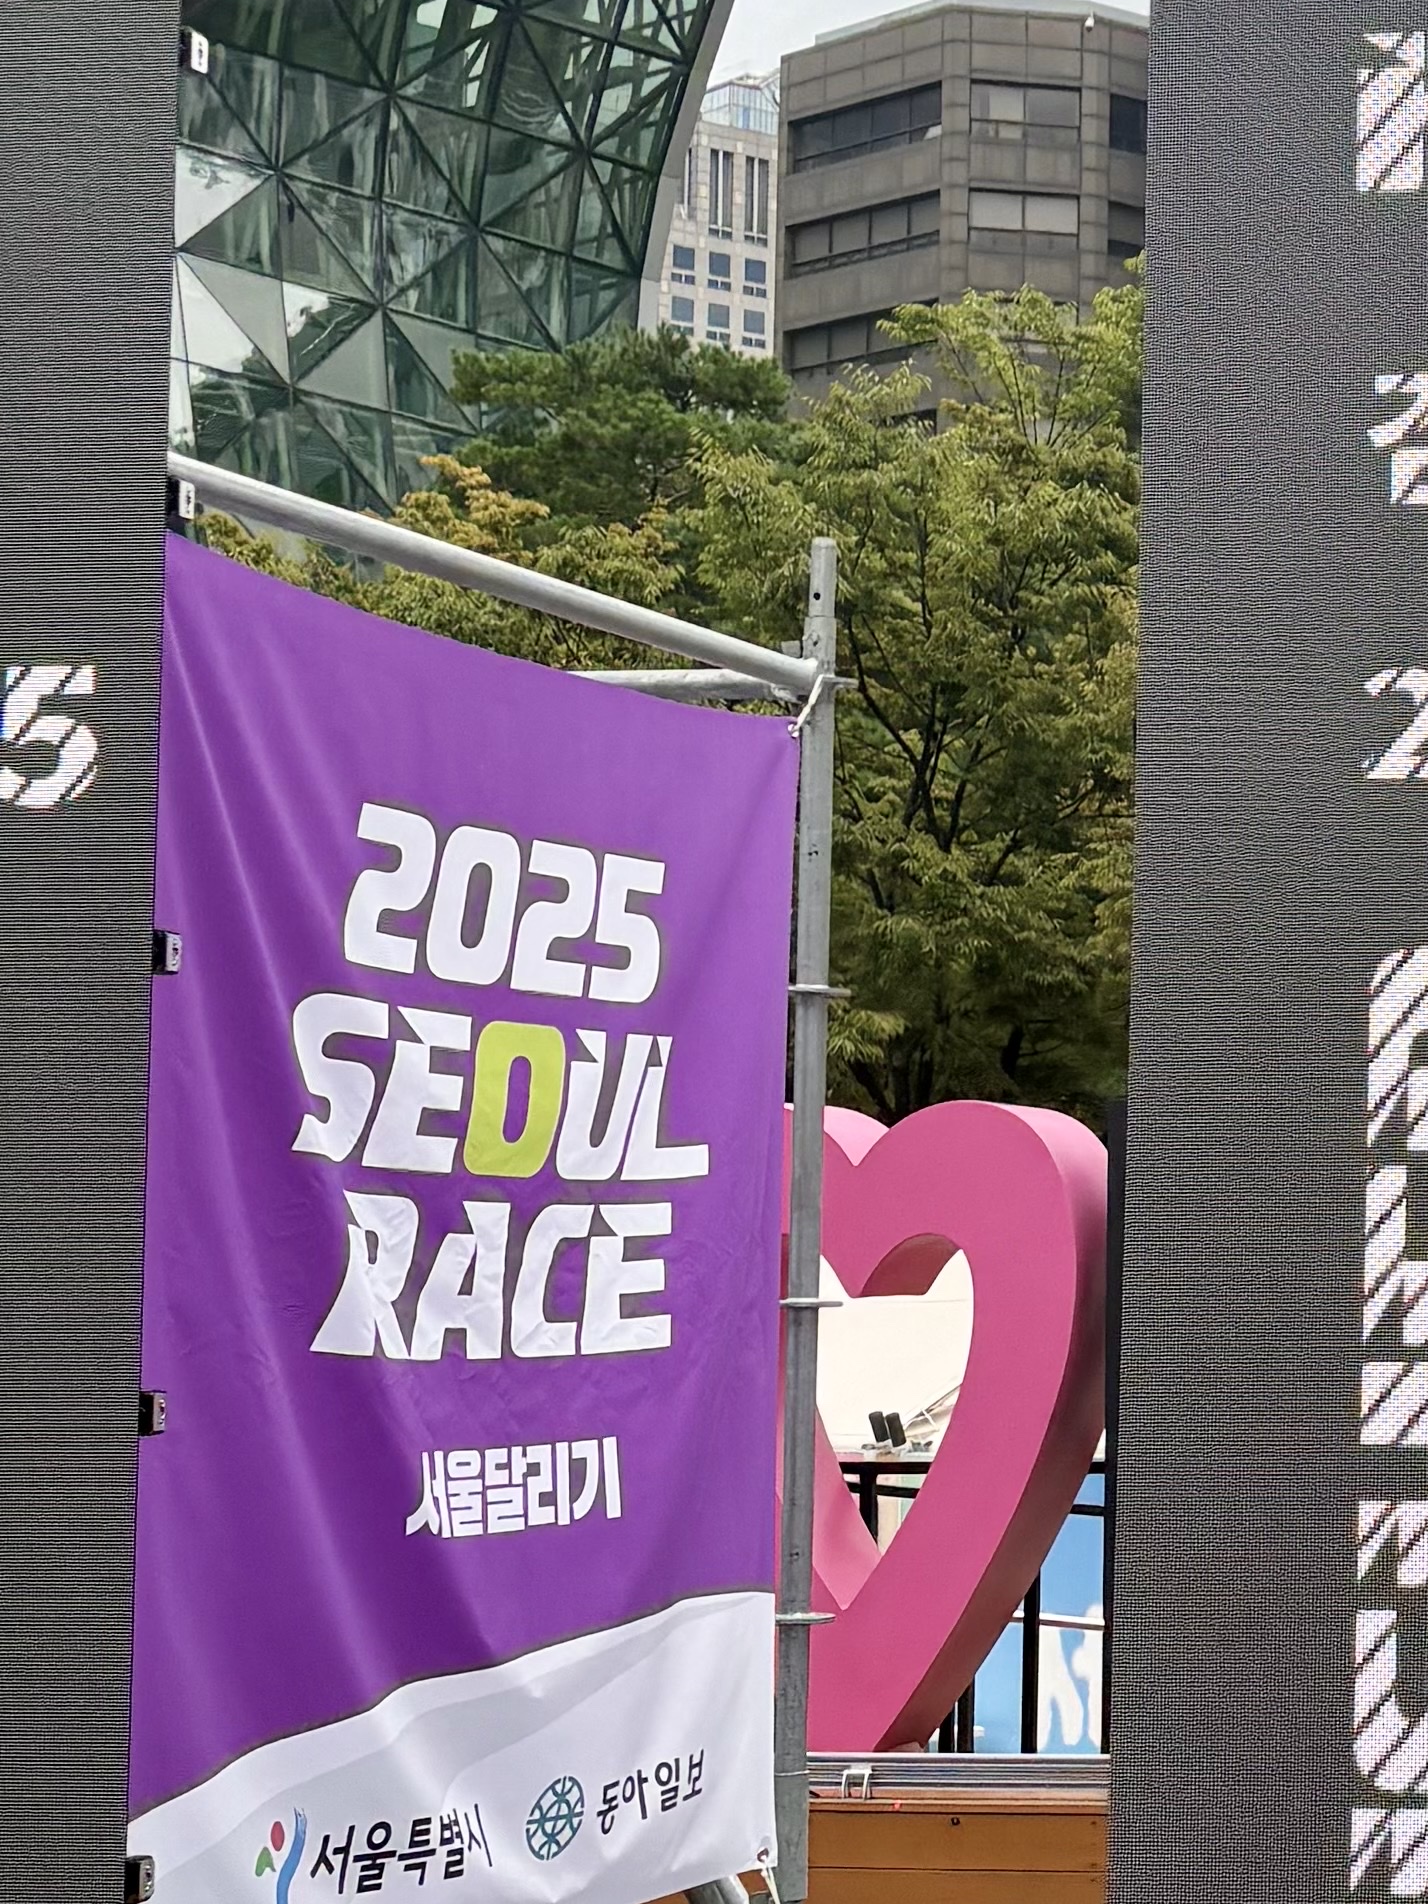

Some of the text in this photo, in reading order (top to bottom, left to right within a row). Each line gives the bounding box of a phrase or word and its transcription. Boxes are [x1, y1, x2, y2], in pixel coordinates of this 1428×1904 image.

[344, 802, 667, 1003] 2025
[291, 992, 710, 1182] SEOUL
[310, 1190, 673, 1362] RACE
[405, 1437, 622, 1539] 서울달리기
[310, 1802, 493, 1896] 서울특별시
[596, 1749, 706, 1834] 동아일보
